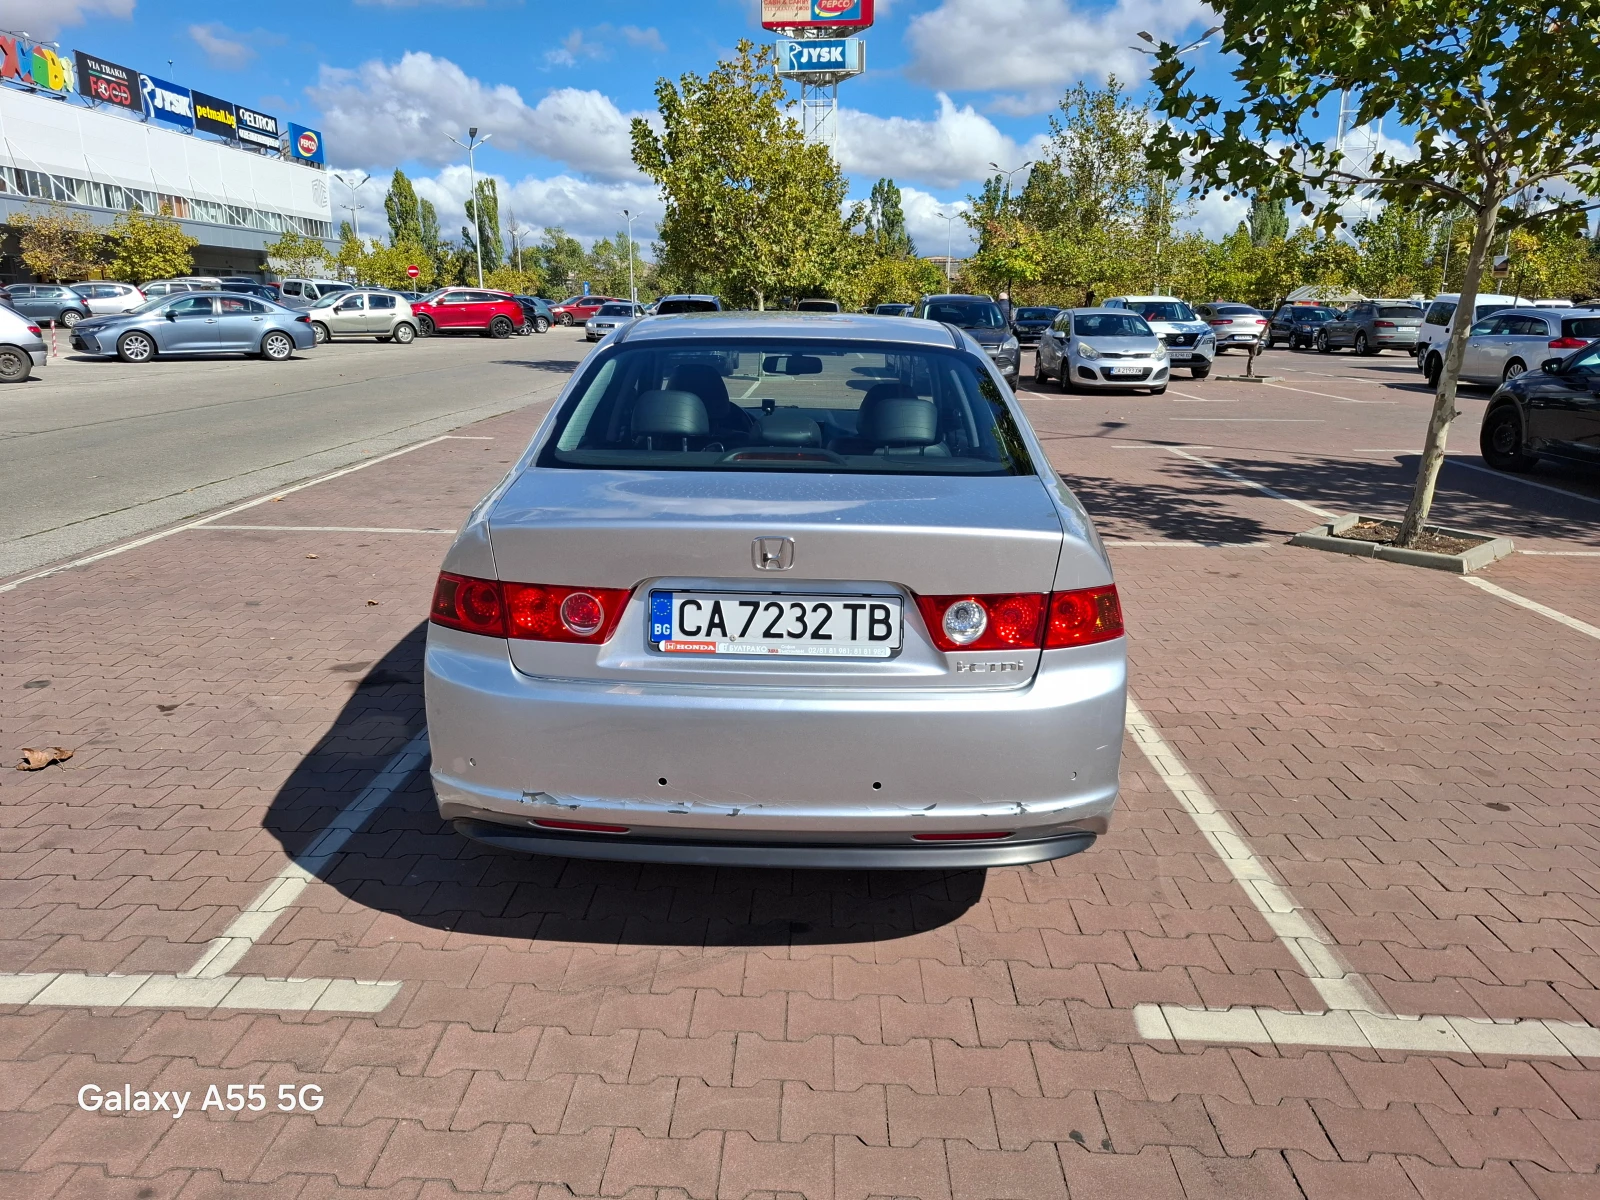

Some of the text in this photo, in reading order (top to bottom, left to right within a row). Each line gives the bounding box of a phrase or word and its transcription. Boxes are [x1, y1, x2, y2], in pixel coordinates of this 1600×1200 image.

[821, 0, 850, 8] PEPCO
[800, 46, 844, 63] JYSK
[87, 59, 128, 80] VIA TRAKIA
[89, 75, 131, 105] FOOD
[154, 87, 193, 118] JYSK
[195, 104, 236, 129] petmall.bg
[300, 138, 317, 152] PEPCO
[679, 599, 893, 641] CA 7232 TB
[654, 623, 671, 635] BG
[676, 642, 715, 651] HONDA
[729, 644, 768, 653] БУЛТРАКО
